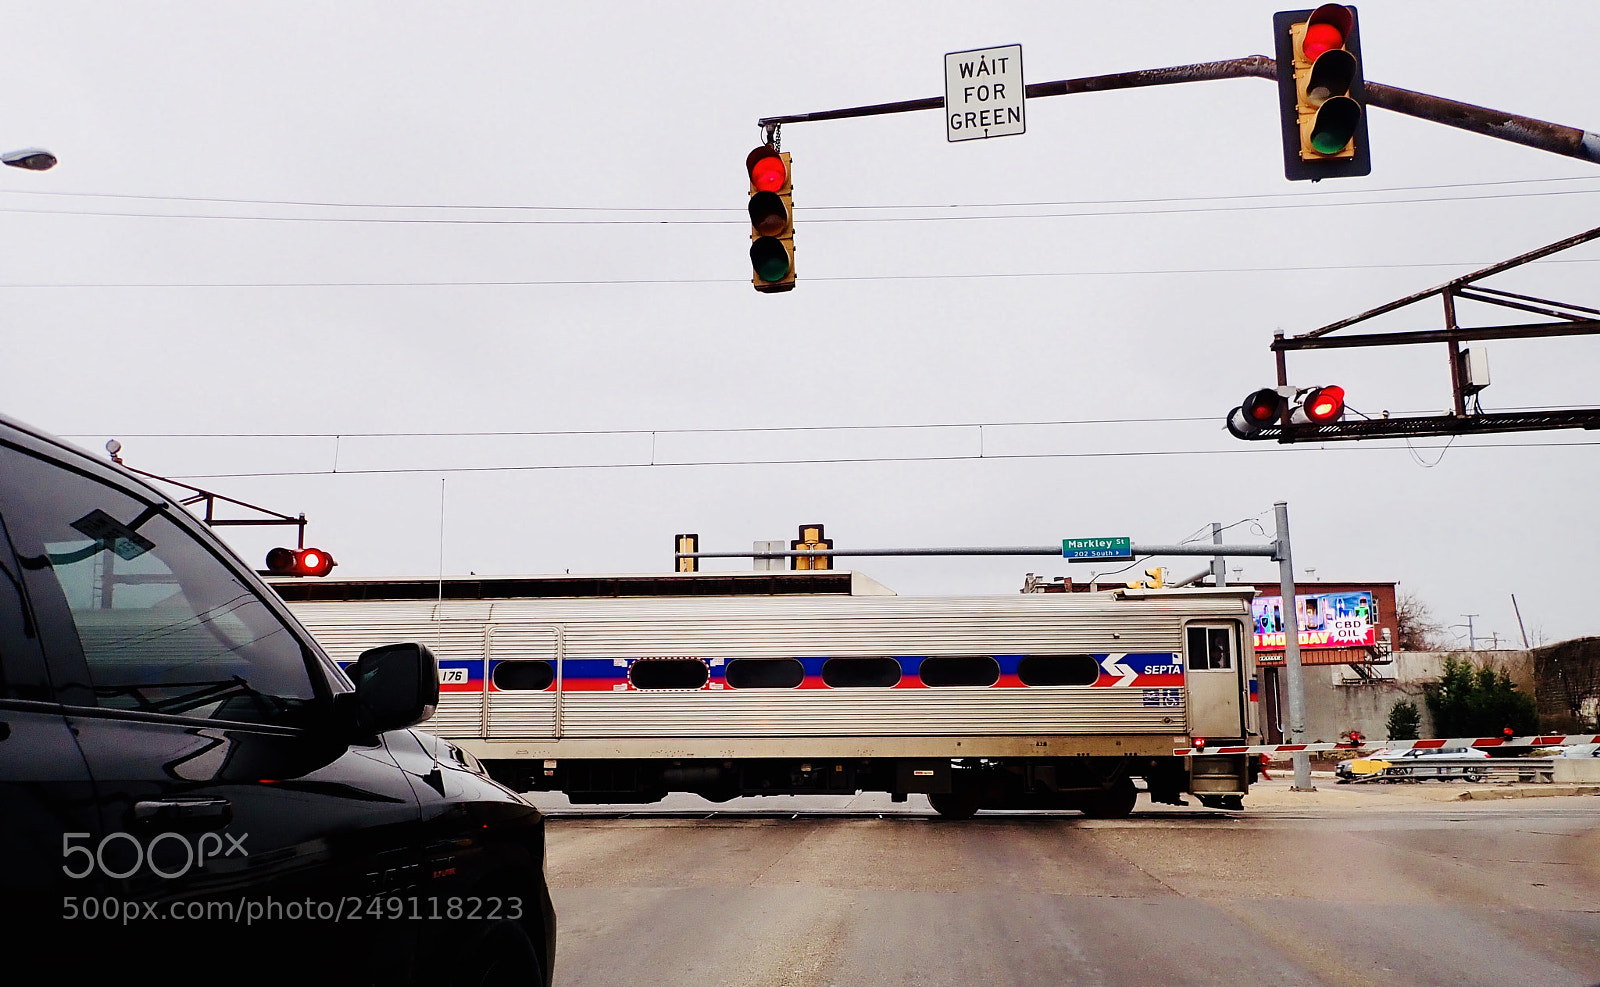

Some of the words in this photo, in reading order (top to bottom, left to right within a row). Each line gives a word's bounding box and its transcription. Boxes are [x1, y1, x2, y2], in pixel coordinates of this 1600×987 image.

[959, 57, 1009, 79] WAIT
[964, 83, 1006, 103] FOR
[950, 106, 1020, 130] GREEN
[1068, 539, 1112, 549] Markley
[1335, 620, 1361, 628] CBD
[1338, 629, 1360, 637] OIL
[1262, 632, 1331, 647] MODAY
[1144, 665, 1181, 675] SEPTA
[442, 671, 463, 681] 176
